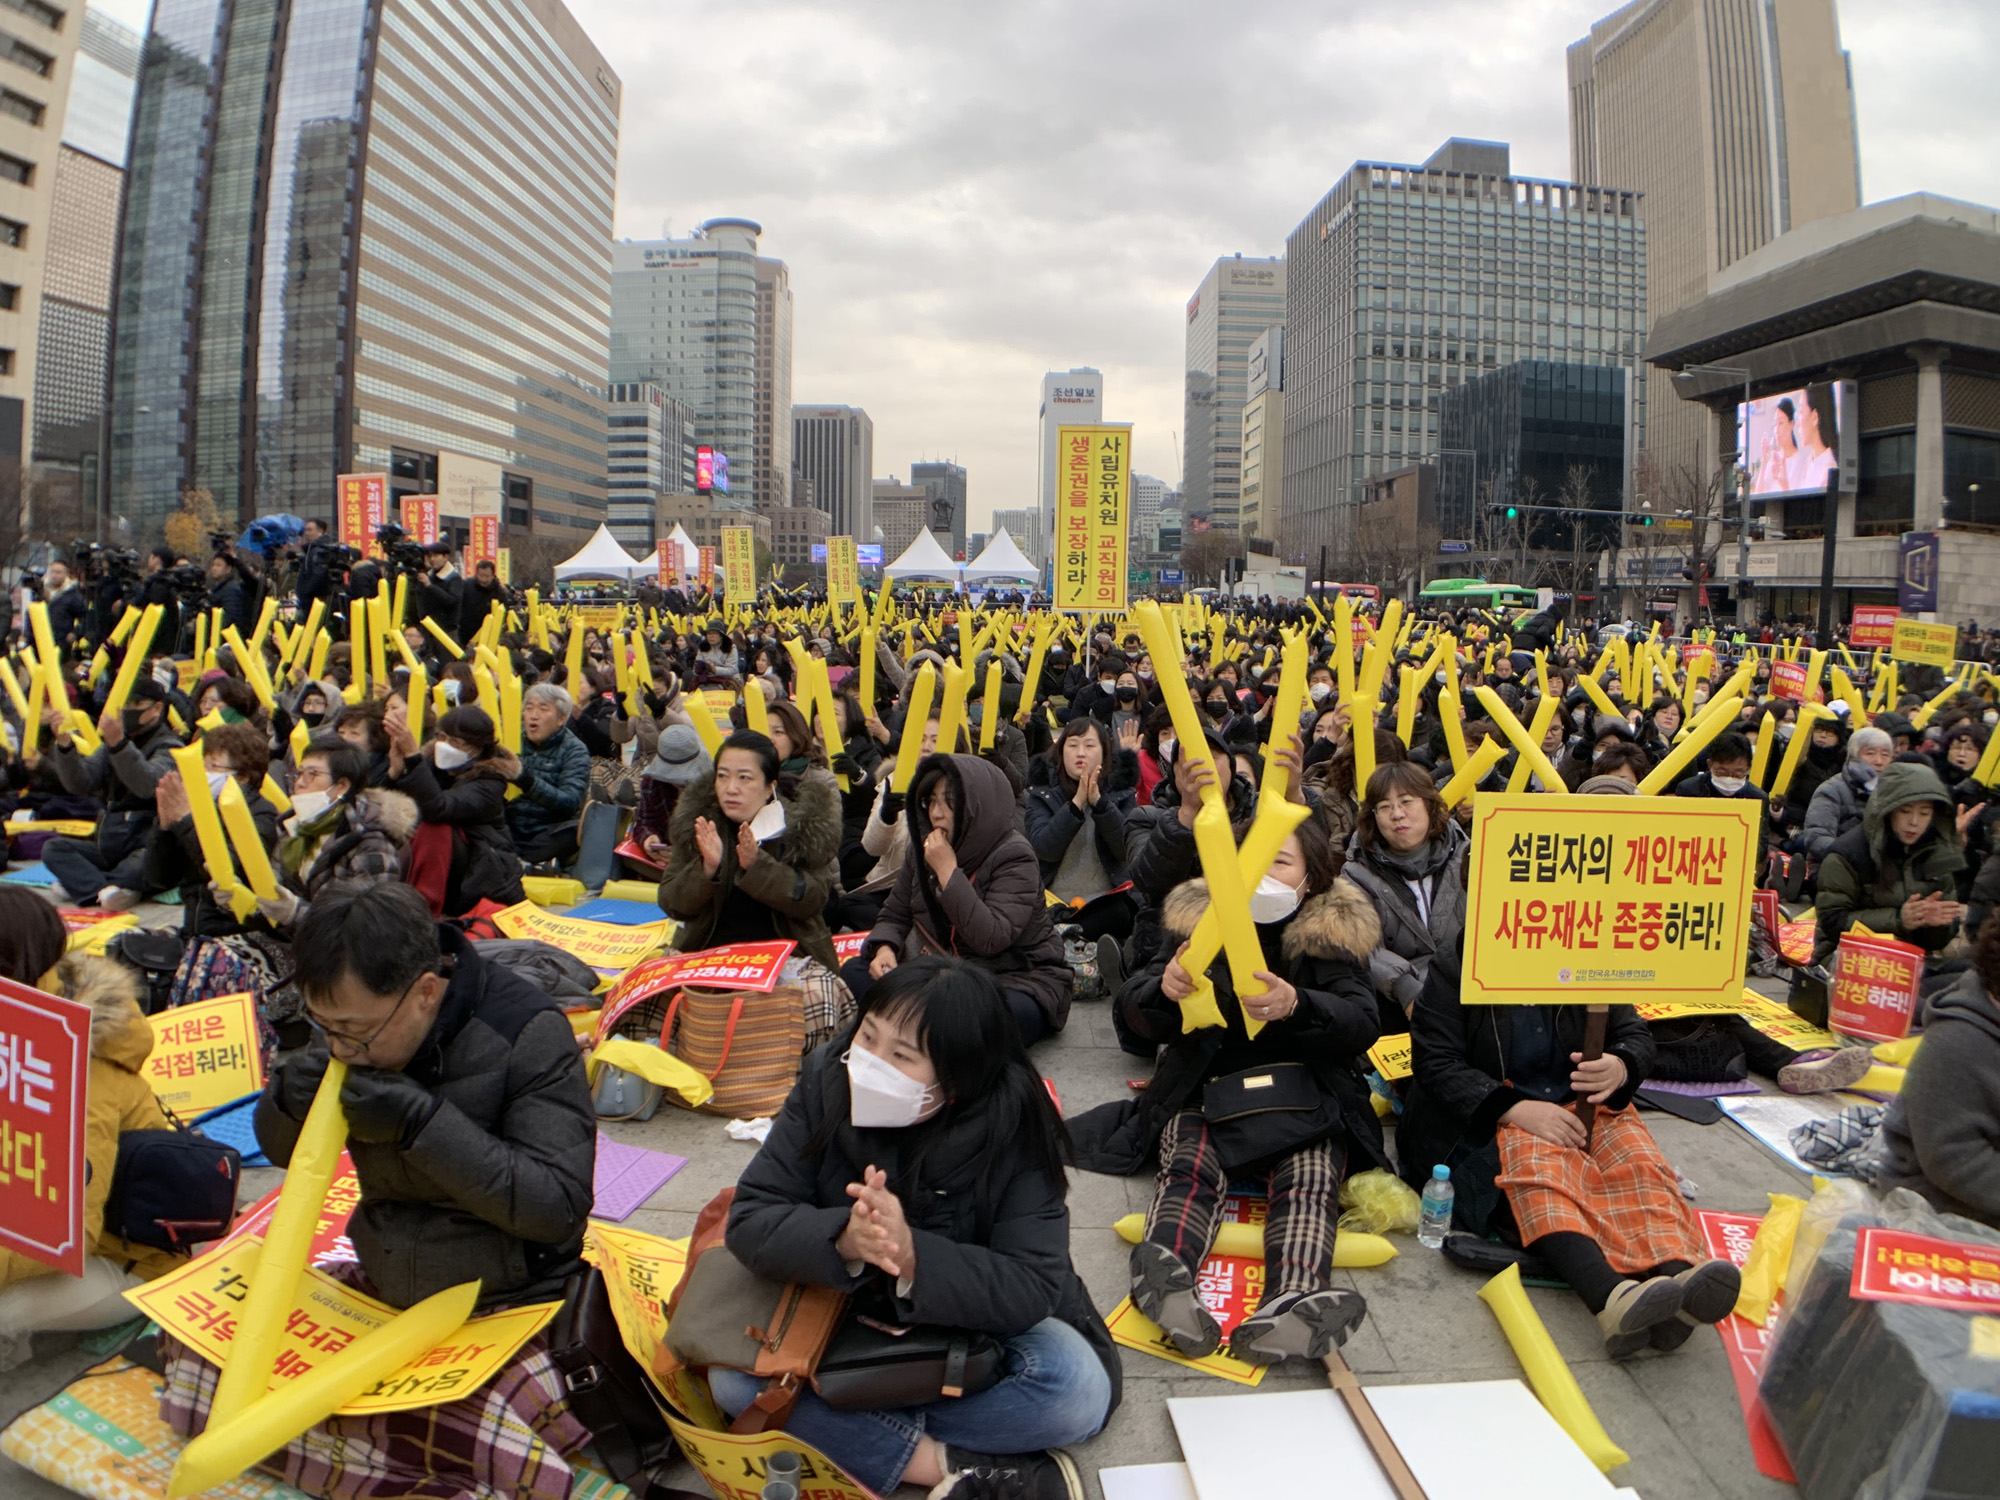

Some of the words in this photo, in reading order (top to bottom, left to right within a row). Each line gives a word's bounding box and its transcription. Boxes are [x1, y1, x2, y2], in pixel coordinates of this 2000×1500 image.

[1053, 387, 1095, 397] 조선일보
[1068, 436, 1090, 508] 생존권을
[1098, 436, 1121, 526] 사립유치원
[1066, 515, 1089, 602] 보장하라!
[1096, 535, 1119, 603] 교직원의
[1507, 832, 1613, 884] 설립자의
[1623, 834, 1727, 885] 개인재산
[528, 914, 588, 938] 대책없는
[592, 930, 651, 944] 사립3법
[1494, 899, 1603, 949] 사유재산
[1611, 901, 1724, 951] 존중하라!
[574, 940, 646, 956] 반대한다!
[682, 953, 773, 970] 유아교육
[672, 965, 763, 981] 대책없는
[1842, 952, 1911, 986] 남발하는
[1837, 979, 1910, 1015] 각성하라!
[160, 1015, 226, 1047] 지원은
[151, 1043, 247, 1080] 직접줘라!
